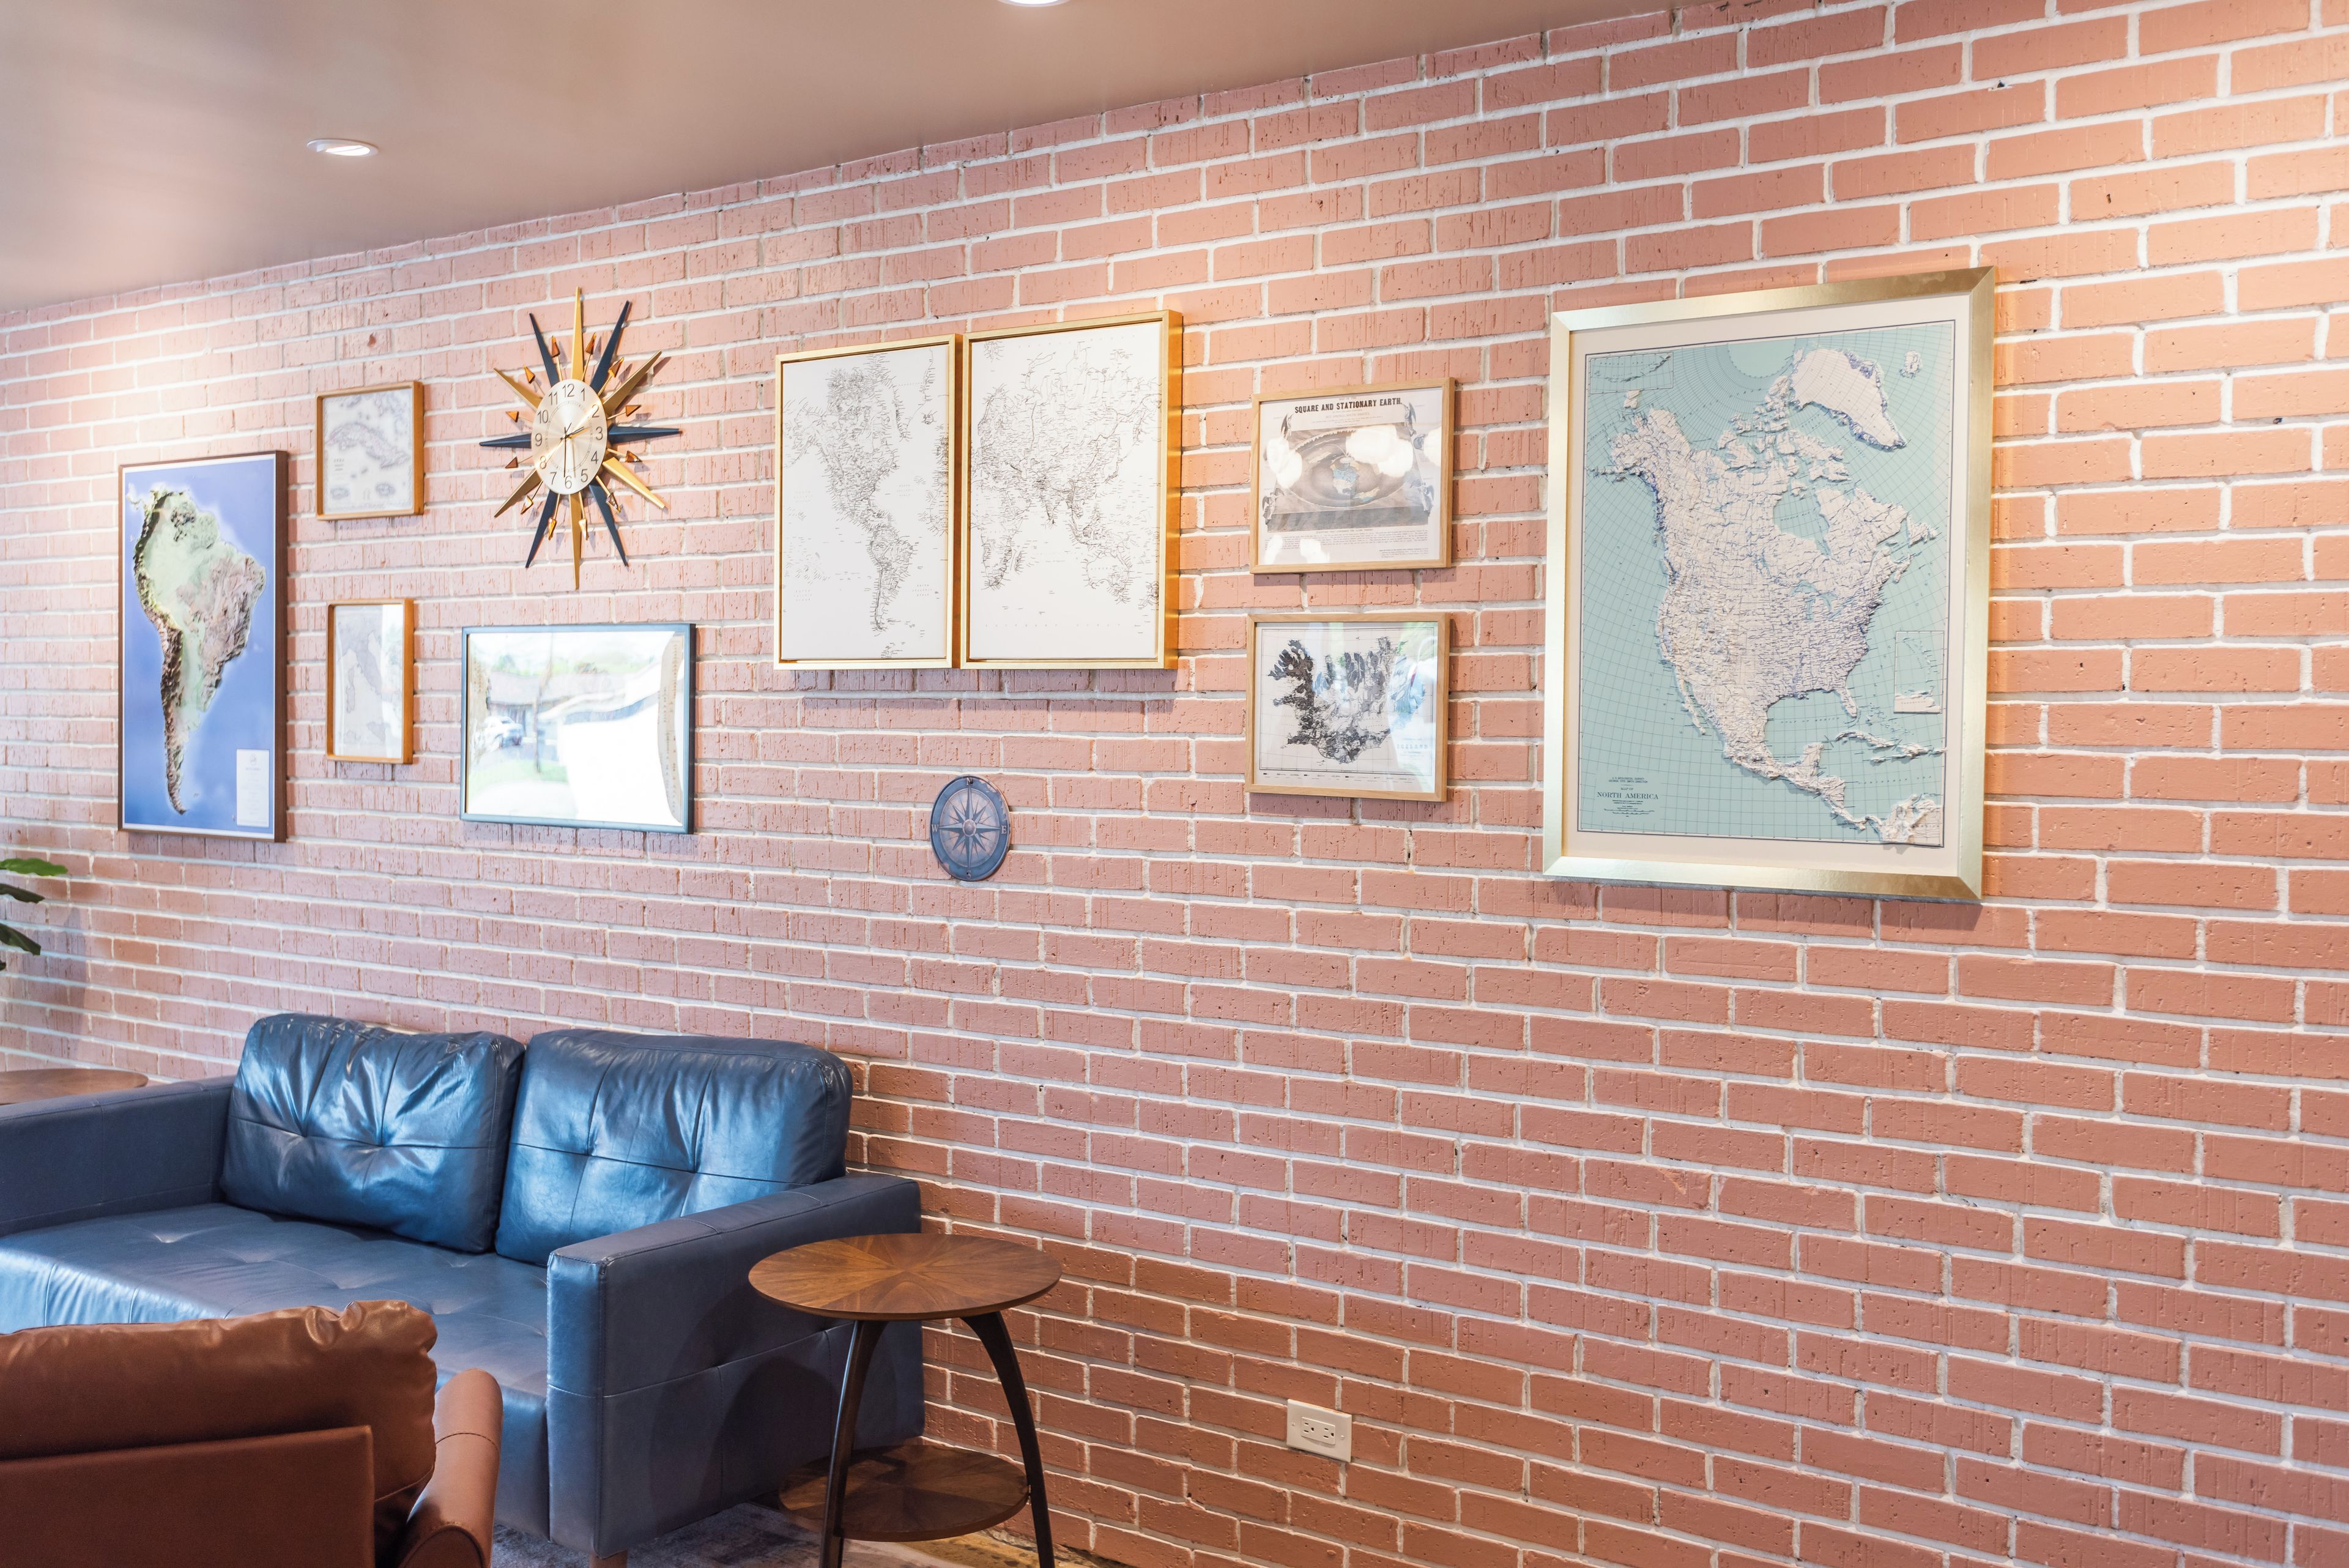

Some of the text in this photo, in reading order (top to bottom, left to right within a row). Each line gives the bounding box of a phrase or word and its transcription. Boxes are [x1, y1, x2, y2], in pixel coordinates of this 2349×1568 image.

[562, 383, 576, 398] 12
[581, 387, 585, 402] 1
[548, 391, 558, 406] 11
[1294, 404, 1319, 414] SQUARE
[1336, 399, 1377, 410] STATIONARY
[1379, 397, 1403, 406] EARTH.
[537, 409, 549, 424] 10
[592, 404, 599, 418] 2
[535, 433, 543, 447] 9
[595, 426, 603, 440] 3
[540, 455, 547, 470] 8
[590, 450, 599, 464] 4
[550, 472, 557, 485] 7
[565, 475, 573, 489] 6
[581, 469, 588, 483] 5
[966, 777, 973, 786] N
[931, 824, 939, 833] W
[1001, 825, 1007, 834] E
[966, 870, 971, 879] S
